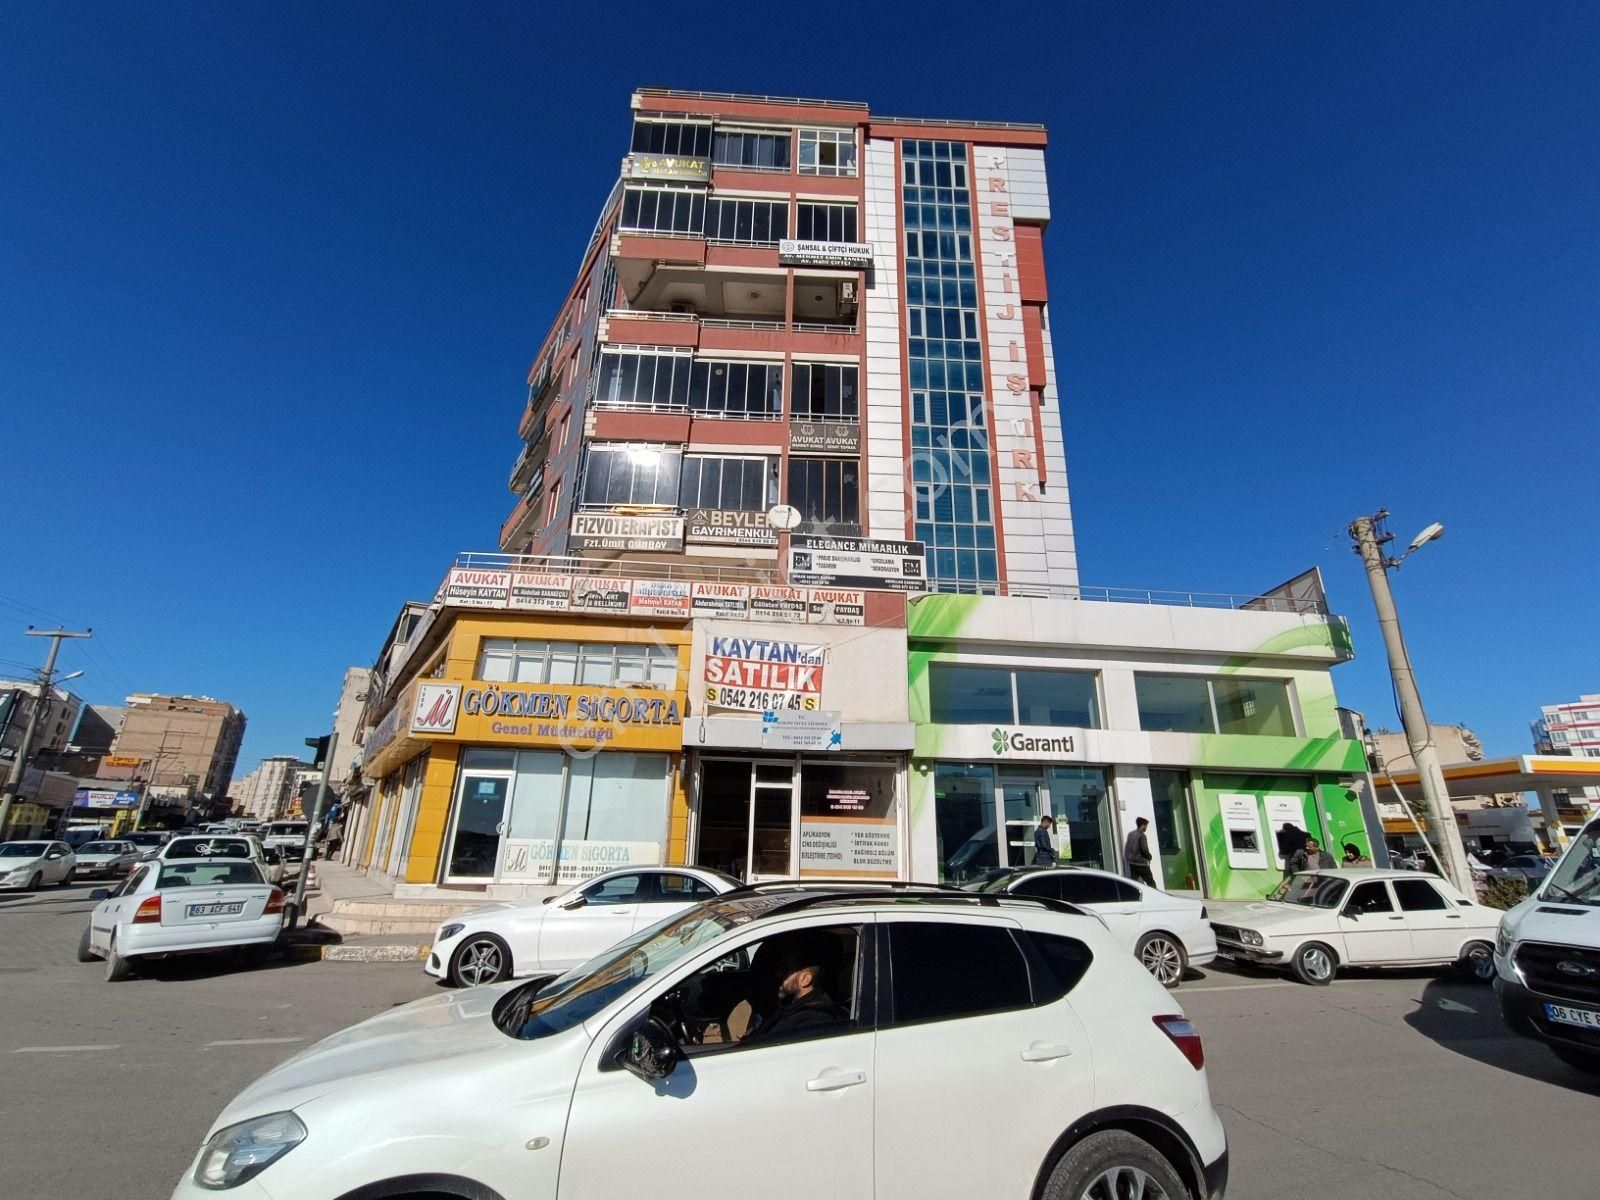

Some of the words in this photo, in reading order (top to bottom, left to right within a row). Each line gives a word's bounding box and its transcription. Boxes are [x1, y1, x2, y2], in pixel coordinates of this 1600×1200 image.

[848, 246, 870, 255] HUKUK
[792, 436, 824, 444] AVUKAT
[825, 437, 858, 445] AVUKAT
[806, 539, 857, 551] ELEGANCE
[455, 573, 507, 586] AVUKAT
[520, 575, 567, 587] AVUKAT
[449, 586, 477, 598] Hüseyin
[477, 588, 507, 599] KAYTAN
[697, 585, 744, 597] AVUKAT
[756, 587, 802, 600] AVUKAT
[813, 591, 860, 604] AVUKAT
[707, 658, 816, 691] SATILIK
[463, 684, 571, 719] GÖKMEN
[707, 688, 717, 701] S
[720, 687, 746, 708] 0542
[748, 690, 769, 710] 216
[787, 694, 802, 711] 45
[804, 698, 815, 711] S
[491, 721, 533, 735] Genel
[537, 724, 614, 742] Müdürlüğü
[1010, 732, 1075, 752] Garanti
[195, 906, 205, 914] 63
[1553, 1007, 1566, 1019] 06
[1570, 1009, 1592, 1024] CYE
